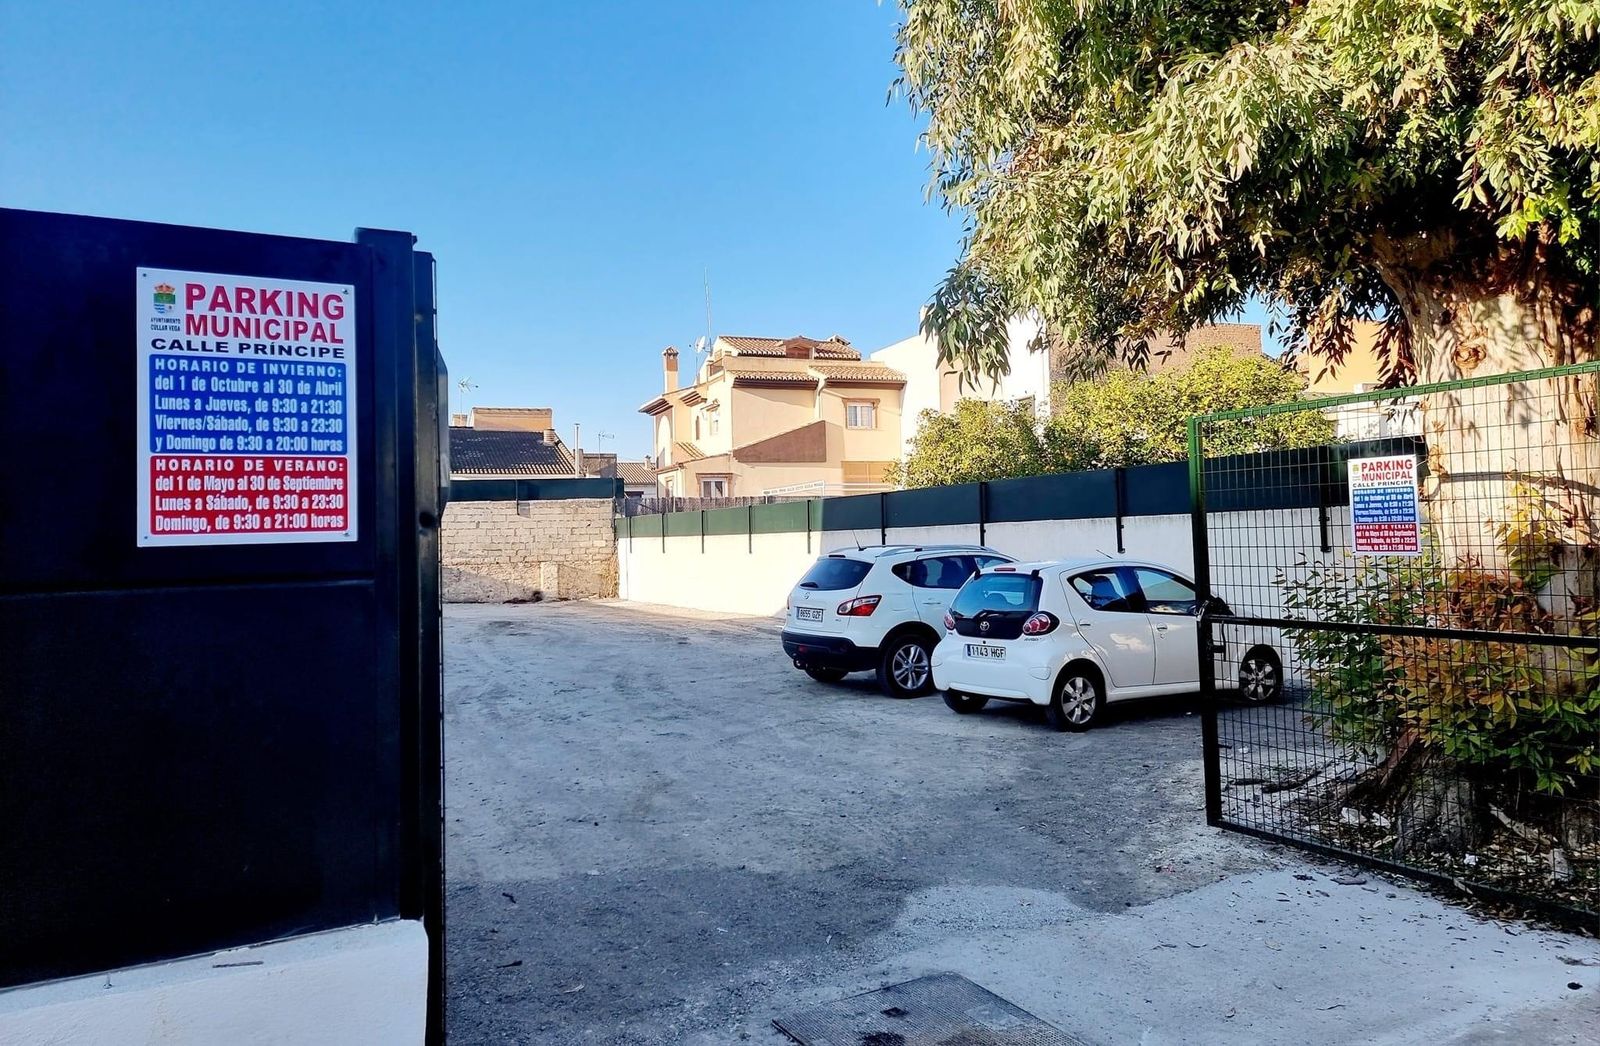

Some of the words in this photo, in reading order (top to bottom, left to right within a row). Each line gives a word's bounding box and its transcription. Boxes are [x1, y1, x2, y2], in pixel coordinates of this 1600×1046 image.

[186, 283, 344, 320] PARKING
[186, 314, 344, 344] MUNICIPAL
[151, 339, 229, 352] CALLE
[239, 342, 344, 359] PRÍNCIPE
[155, 359, 229, 373] HORARIO
[237, 362, 255, 373] DE
[263, 363, 341, 377] INVIERNO:
[155, 375, 173, 390] del
[180, 376, 185, 390] 1
[192, 377, 205, 391] de
[211, 377, 258, 393] Octubre
[264, 379, 273, 394] al
[278, 380, 292, 394] 30
[298, 380, 310, 395] de
[315, 381, 342, 396] Abril
[155, 395, 190, 411] Lunes
[195, 399, 201, 411] a
[206, 397, 250, 414] Jueves,
[255, 398, 268, 412] de
[272, 398, 297, 413] 9:30
[301, 402, 307, 413] a
[311, 400, 342, 414] 21:30
[155, 414, 252, 433] Viernes/Sábado,
[256, 417, 269, 431] de
[273, 417, 297, 432] 9:30
[301, 420, 308, 432] a
[311, 418, 342, 433] 23:30
[155, 437, 162, 451] y
[167, 435, 216, 452] Domingo
[220, 436, 233, 450] de
[237, 436, 262, 450] 9:30
[266, 439, 272, 450] a
[276, 436, 307, 451] 20:00
[311, 437, 342, 451] horas
[156, 459, 234, 471] HORARIO
[244, 460, 264, 471] DE
[274, 460, 344, 471] VERANO:
[1362, 459, 1412, 472] PARKING
[156, 476, 173, 491] del
[177, 476, 182, 490] 1
[187, 476, 200, 490] de
[204, 476, 234, 493] Mayo
[238, 476, 247, 490] al
[250, 476, 264, 490] 30
[268, 476, 280, 490] de
[283, 475, 343, 493] Septiembre
[1362, 471, 1412, 481] MUNICIPAL
[156, 496, 191, 510] Lunes
[195, 499, 202, 510] a
[206, 494, 252, 512] Sábado,
[256, 495, 269, 510] de
[273, 495, 298, 509] 9:30
[302, 498, 308, 509] a
[312, 495, 343, 509] 23:30
[156, 515, 211, 532] Domingo,
[215, 515, 229, 529] de
[234, 514, 259, 529] 9:30
[264, 517, 271, 528] a
[275, 514, 307, 528] 21:00
[311, 514, 343, 528] horas
[972, 646, 988, 657] 1143
[991, 649, 1005, 658] HGF
